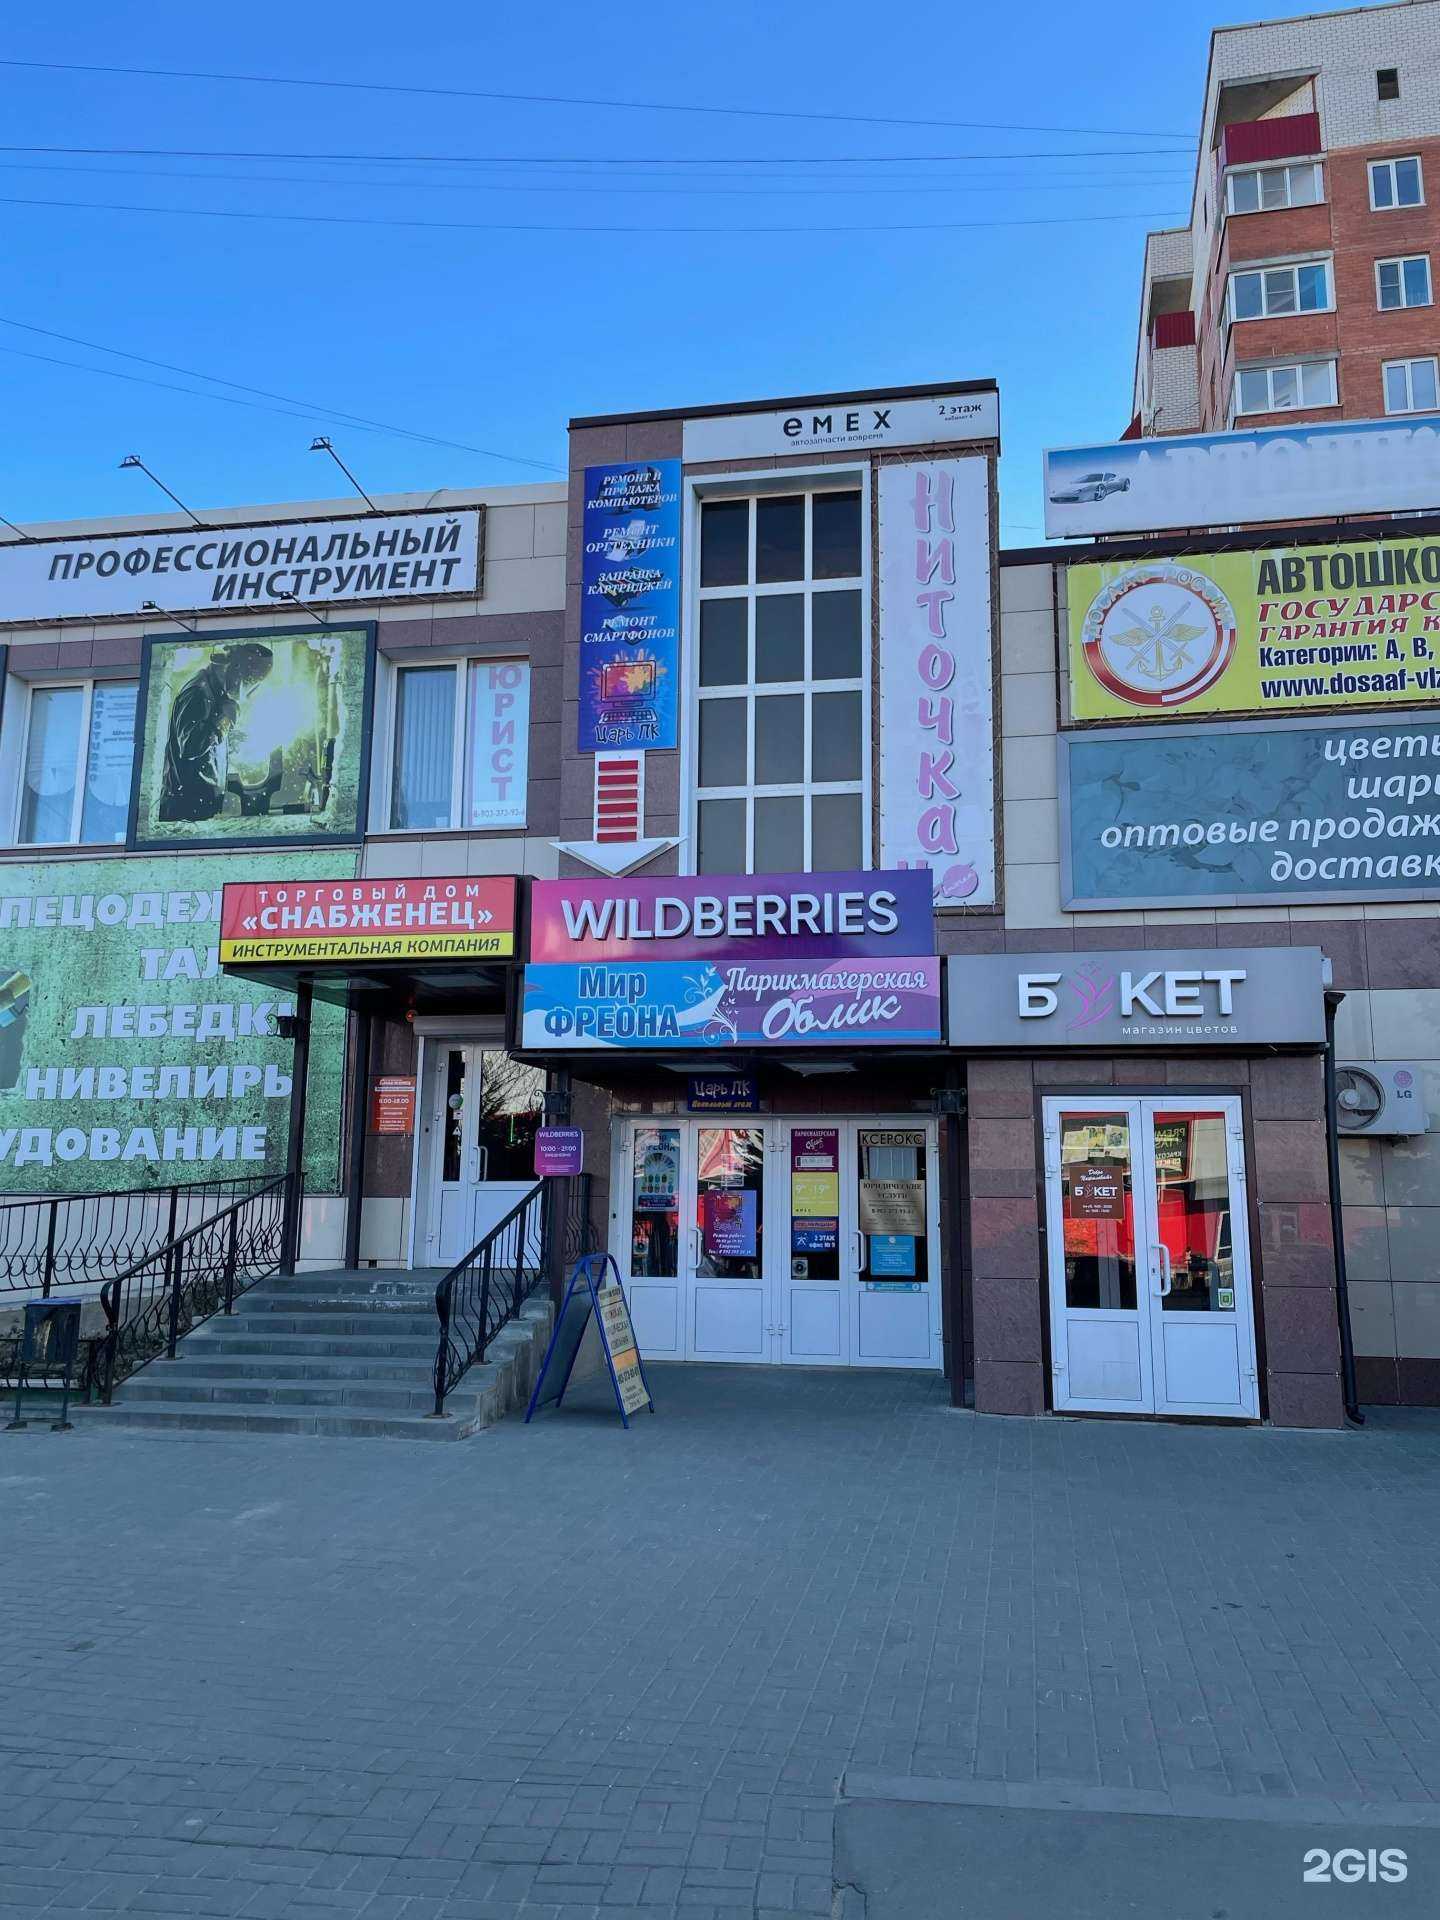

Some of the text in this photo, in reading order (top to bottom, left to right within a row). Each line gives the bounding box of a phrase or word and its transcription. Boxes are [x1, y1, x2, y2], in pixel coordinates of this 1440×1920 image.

[938, 403, 982, 415] 2 этаж
[791, 433, 884, 447] автозапчасти вовремя
[603, 471, 662, 485] РЕМОНТ И
[604, 482, 661, 497] ПРОДАЖА
[587, 493, 677, 510] КОМПЬЮТЕРОВ
[603, 524, 659, 539] РЕМОНТ
[48, 518, 462, 581] ПРОФЕССИОНАЛЬНЫЙ
[586, 536, 675, 553] ОРГТЕХНИКИ
[212, 557, 461, 602] ИНСТРУМЕНТ
[598, 568, 661, 582] ЗАПРАВКА
[587, 578, 672, 595] КАРТРИДЖЕЙ
[602, 616, 658, 629] РЕМОНТ
[1259, 616, 1409, 642] ГАРАНТИЯ
[583, 628, 675, 643] СМАРТФОНОВ
[1260, 643, 1378, 667] Категории:
[488, 664, 522, 802] ЮРИСТ
[595, 722, 660, 745] Царь ПК
[1101, 807, 1440, 849] оптовые продаж
[259, 883, 480, 903] ТОРГОВЫЙ ДОМ
[242, 901, 494, 931] «СНАБЖЕНЕЦ»
[560, 889, 900, 941] WILDBERRIES
[232, 937, 500, 959] ИНСТРУМЕНТАЛЬНАЯ КОМПАНИЯ
[578, 967, 647, 1004] Мир
[725, 967, 926, 1001] Парикмахерская
[544, 1003, 681, 1039] ФРЕОНА
[762, 993, 902, 1040] Облик
[1122, 1023, 1239, 1036] магазин цветов
[694, 1079, 750, 1099] Царь ПК
[1396, 1089, 1413, 1099] LG
[862, 1133, 923, 1145] КСЕРОКС
[863, 1182, 922, 1190] ЮРИДИЧЕСКИЕ
